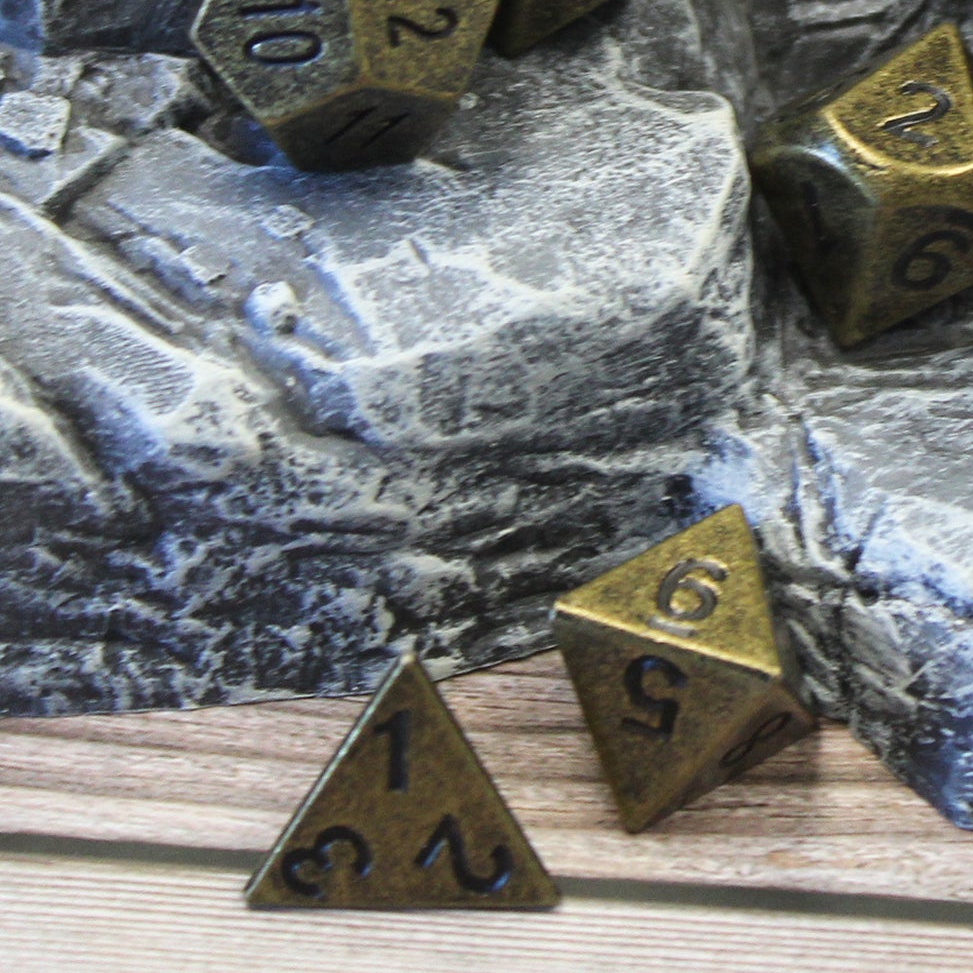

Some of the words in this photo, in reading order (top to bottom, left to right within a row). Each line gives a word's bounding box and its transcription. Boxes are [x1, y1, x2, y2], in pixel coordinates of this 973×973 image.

[878, 81, 953, 148] 2
[655, 557, 729, 627] 6
[621, 655, 688, 743] 5
[373, 709, 413, 793] 1
[719, 711, 793, 767] 8
[281, 824, 374, 900] 3
[413, 812, 515, 894] 2
